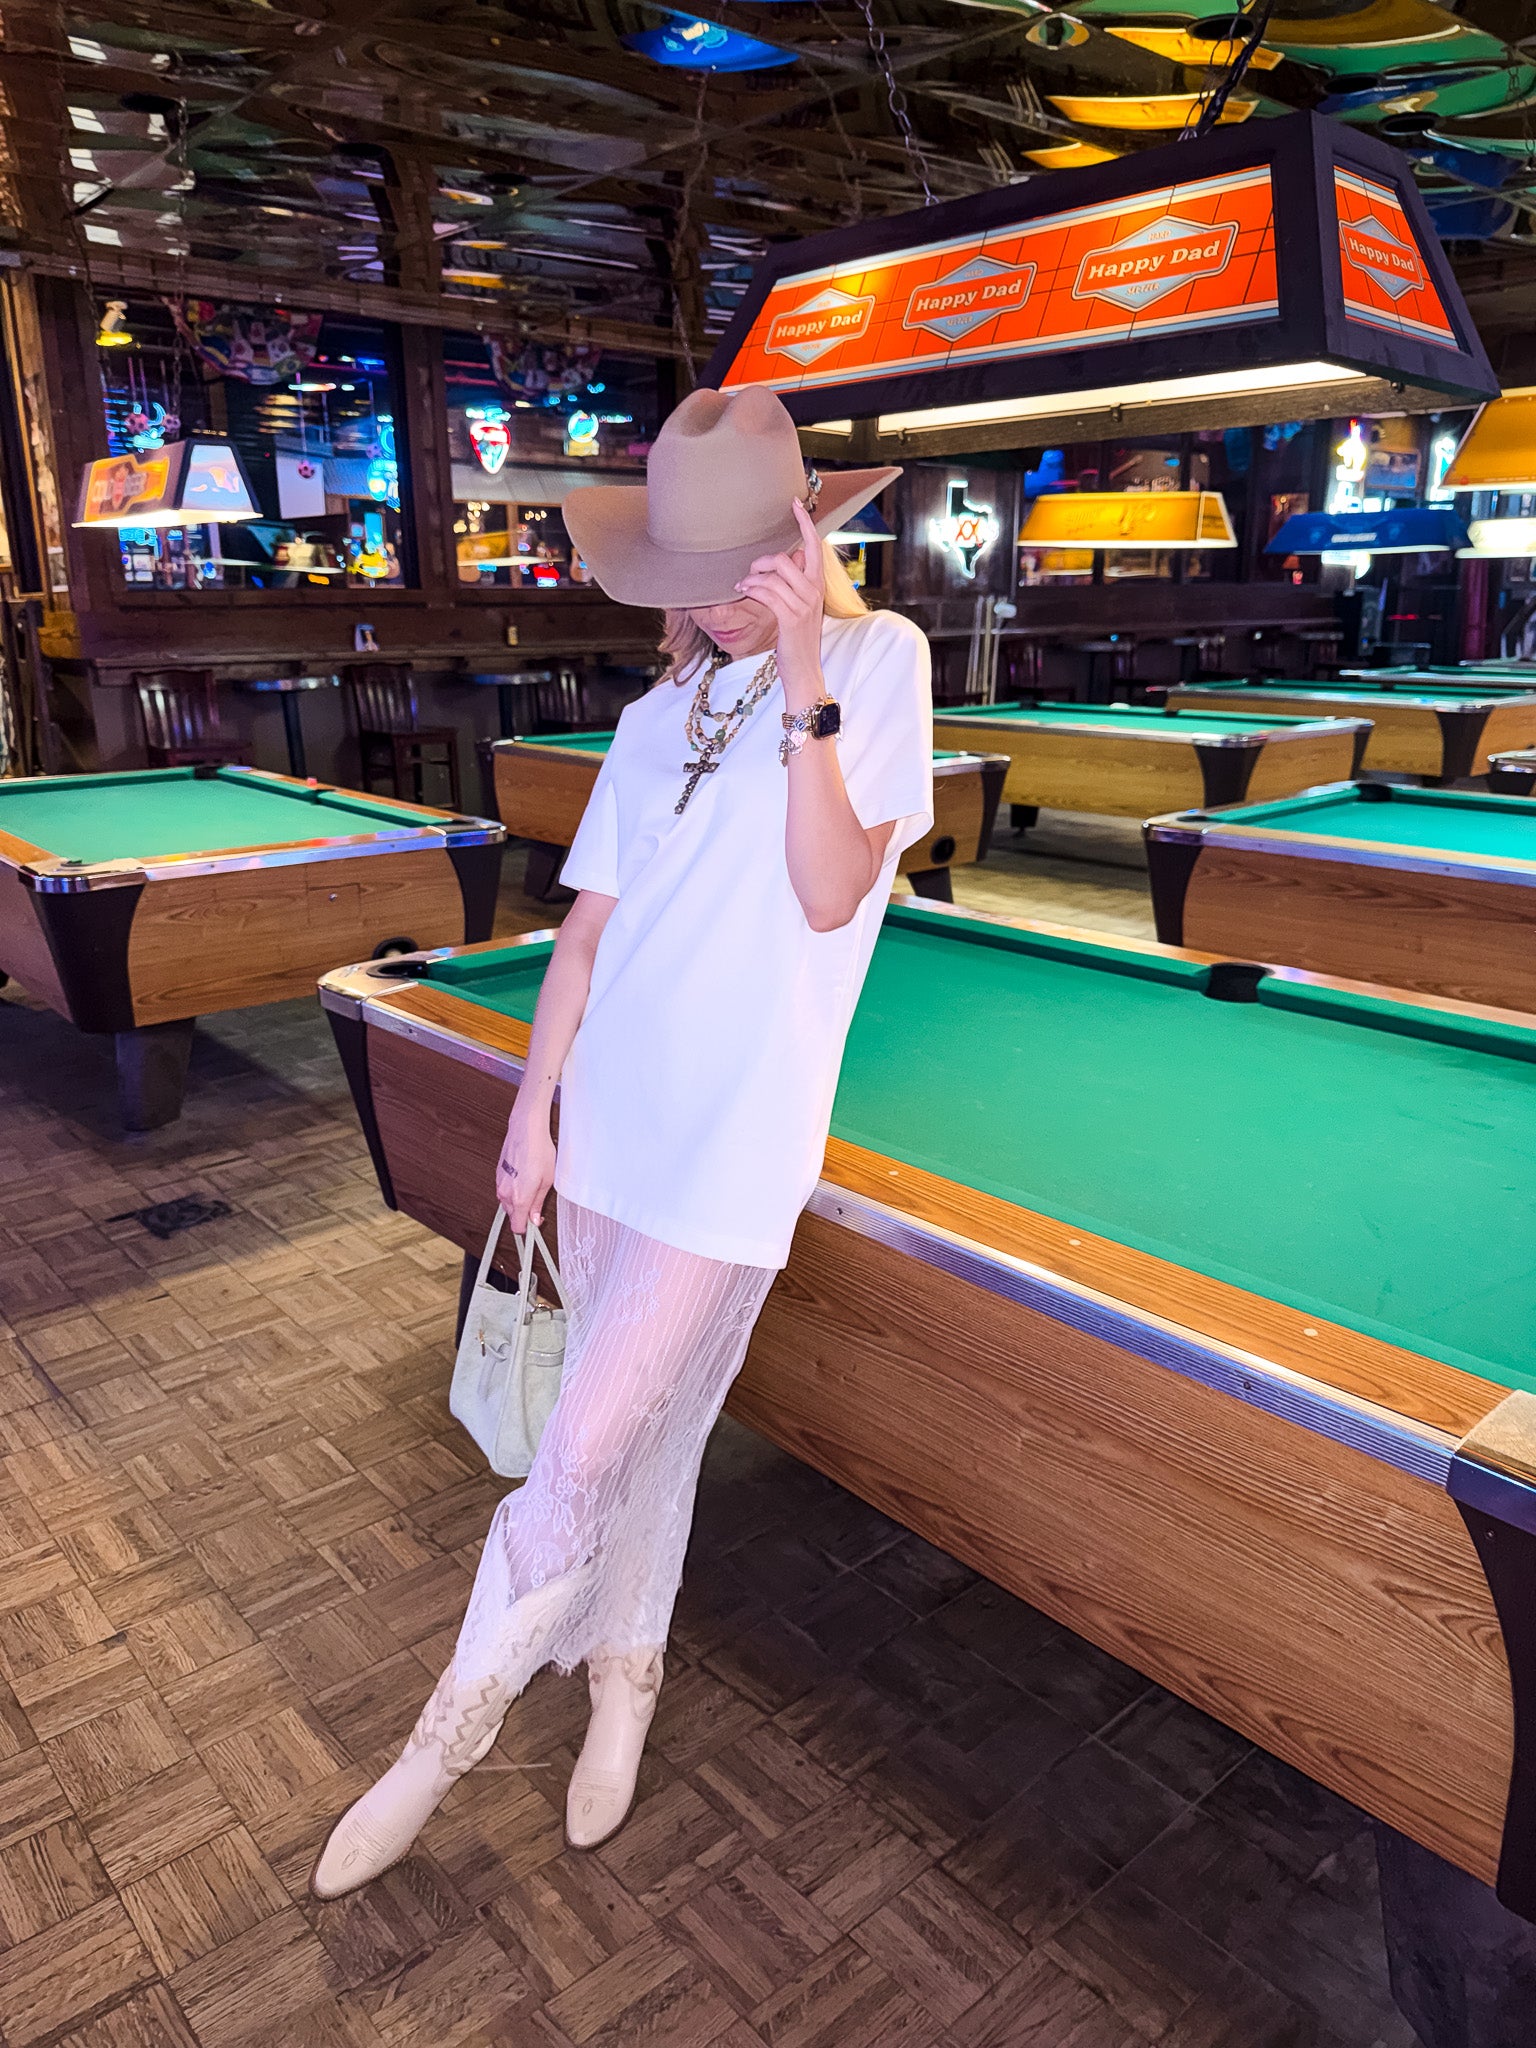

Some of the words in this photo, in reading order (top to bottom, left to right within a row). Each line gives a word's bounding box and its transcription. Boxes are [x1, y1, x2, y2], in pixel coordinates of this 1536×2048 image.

[1088, 254, 1165, 281] Happy
[1169, 240, 1220, 265] Dad
[1349, 237, 1390, 266] Happy
[1391, 253, 1415, 273] Dad
[916, 290, 978, 312] Happy
[981, 278, 1022, 300] Dad
[775, 317, 828, 338] Happy
[830, 310, 863, 328] Dad
